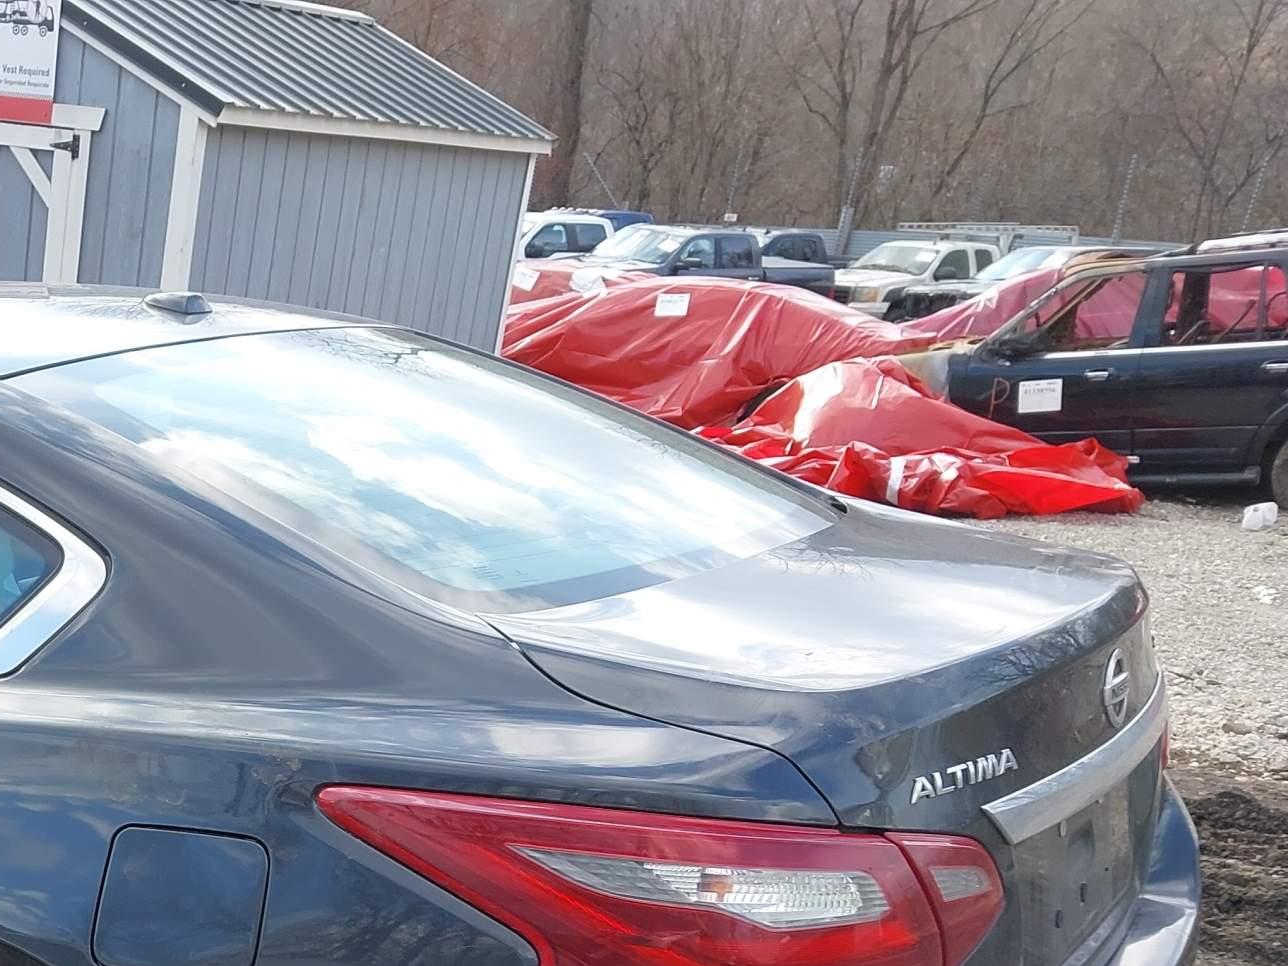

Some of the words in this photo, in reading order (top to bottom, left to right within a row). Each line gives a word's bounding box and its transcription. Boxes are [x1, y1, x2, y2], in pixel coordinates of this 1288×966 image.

[2, 63, 17, 74] Vest
[19, 65, 50, 78] Required
[910, 748, 1019, 804] ALTIMA
